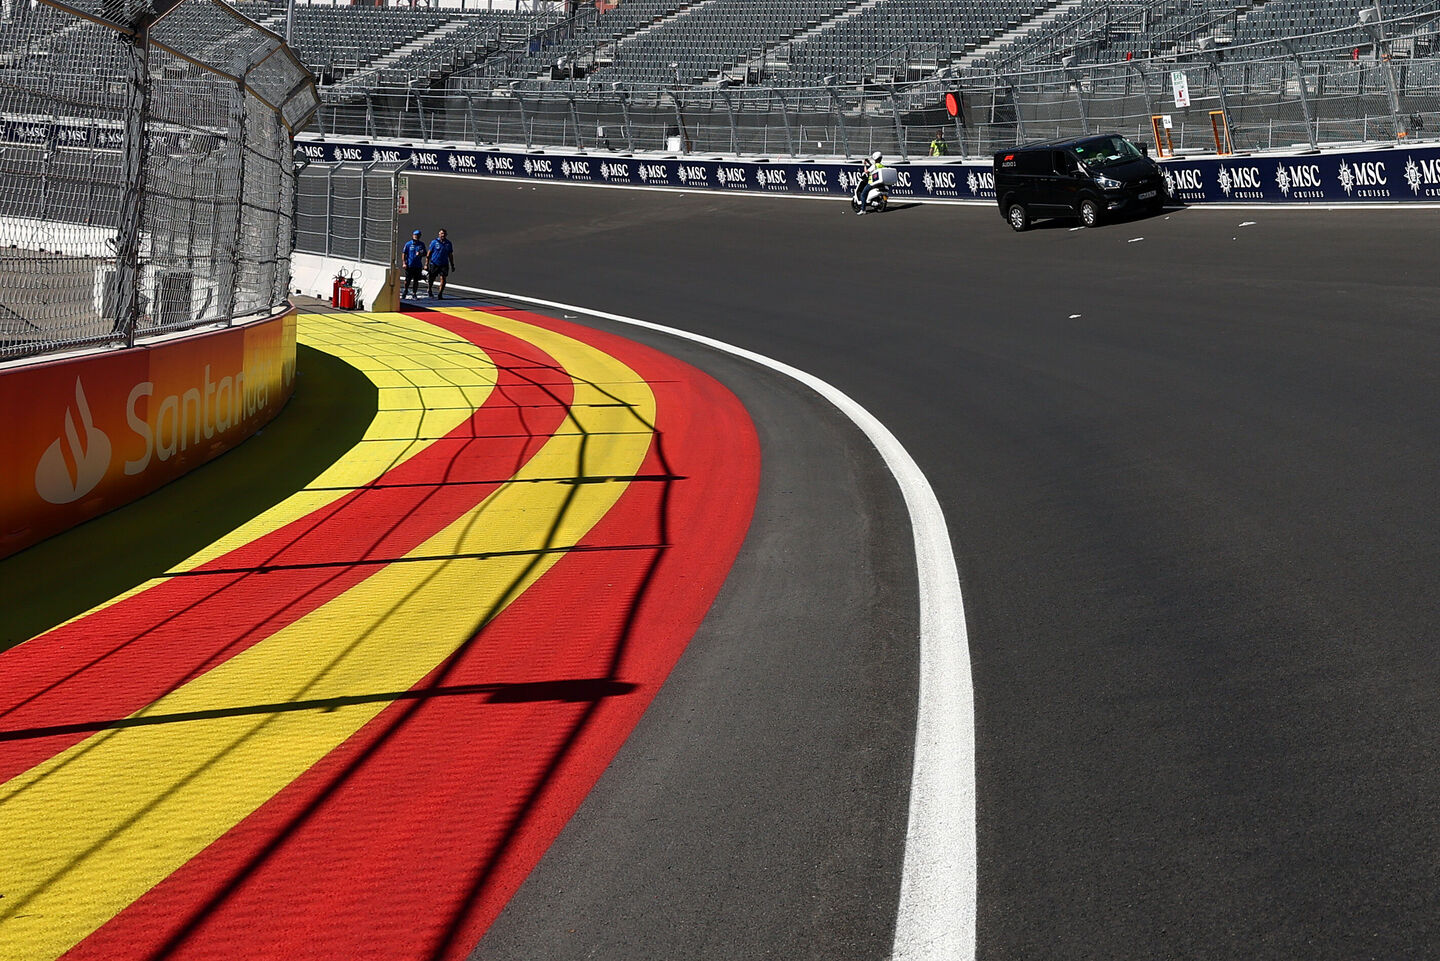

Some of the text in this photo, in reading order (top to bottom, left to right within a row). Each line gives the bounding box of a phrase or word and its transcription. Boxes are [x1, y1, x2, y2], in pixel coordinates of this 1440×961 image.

[305, 146, 324, 158] MSC
[342, 148, 363, 161] MSC
[381, 150, 400, 162] MSC
[419, 153, 437, 166] MSC
[457, 155, 476, 167] MSC
[494, 157, 513, 169] MSC
[533, 160, 552, 173] MSC
[570, 162, 589, 175] MSC
[609, 164, 628, 176] MSC
[647, 165, 667, 178] MSC
[687, 166, 706, 180] MSC
[726, 168, 745, 181] MSC
[766, 170, 786, 183] MSC
[806, 171, 827, 185] MSC
[933, 172, 955, 188] MSC
[1175, 169, 1202, 189] MSC
[1231, 167, 1260, 187] MSC
[1289, 165, 1320, 187] MSC
[1352, 162, 1386, 185] MSC
[977, 173, 995, 189] MS
